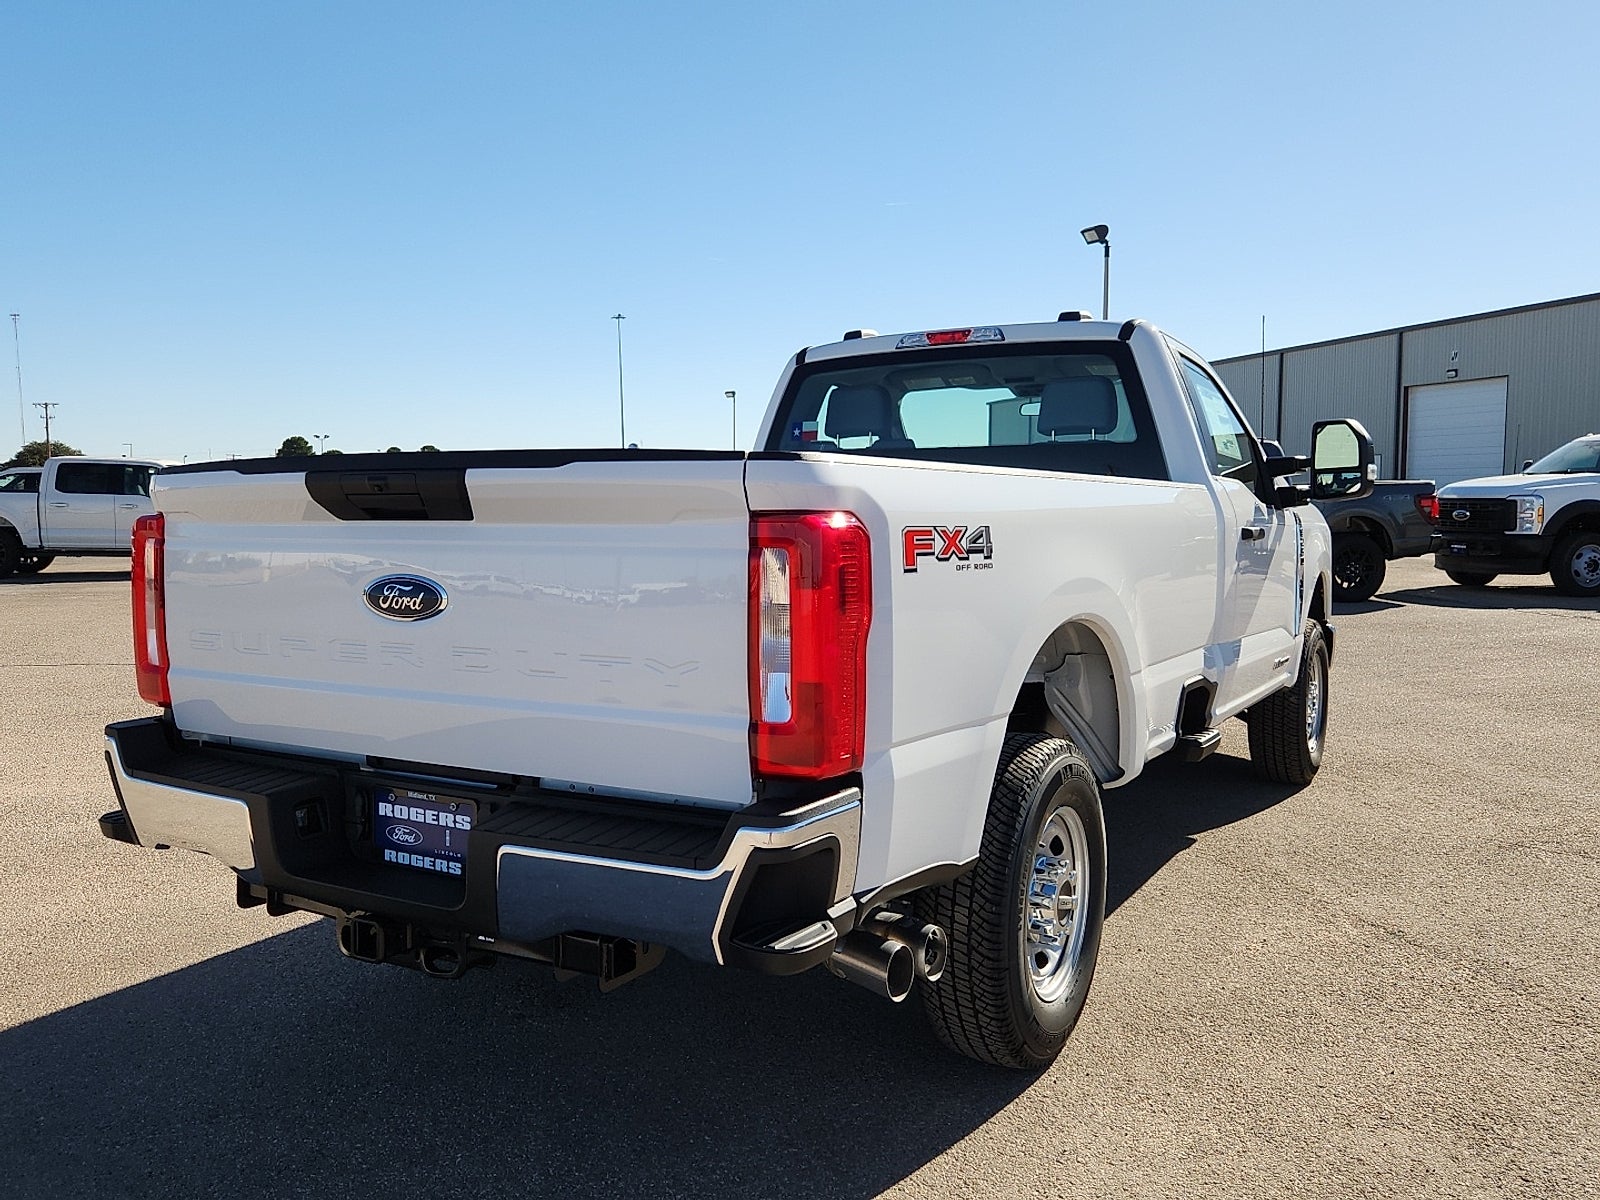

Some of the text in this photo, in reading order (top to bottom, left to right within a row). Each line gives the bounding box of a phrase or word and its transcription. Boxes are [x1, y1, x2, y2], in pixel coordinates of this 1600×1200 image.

[902, 526, 993, 573] FX4
[379, 583, 425, 611] Ford
[190, 629, 700, 688] SUPER DUTY
[378, 802, 472, 831] ROGERS
[392, 826, 416, 843] Ford
[384, 849, 462, 875] ROGERS
[434, 848, 462, 858] LINCOLN
